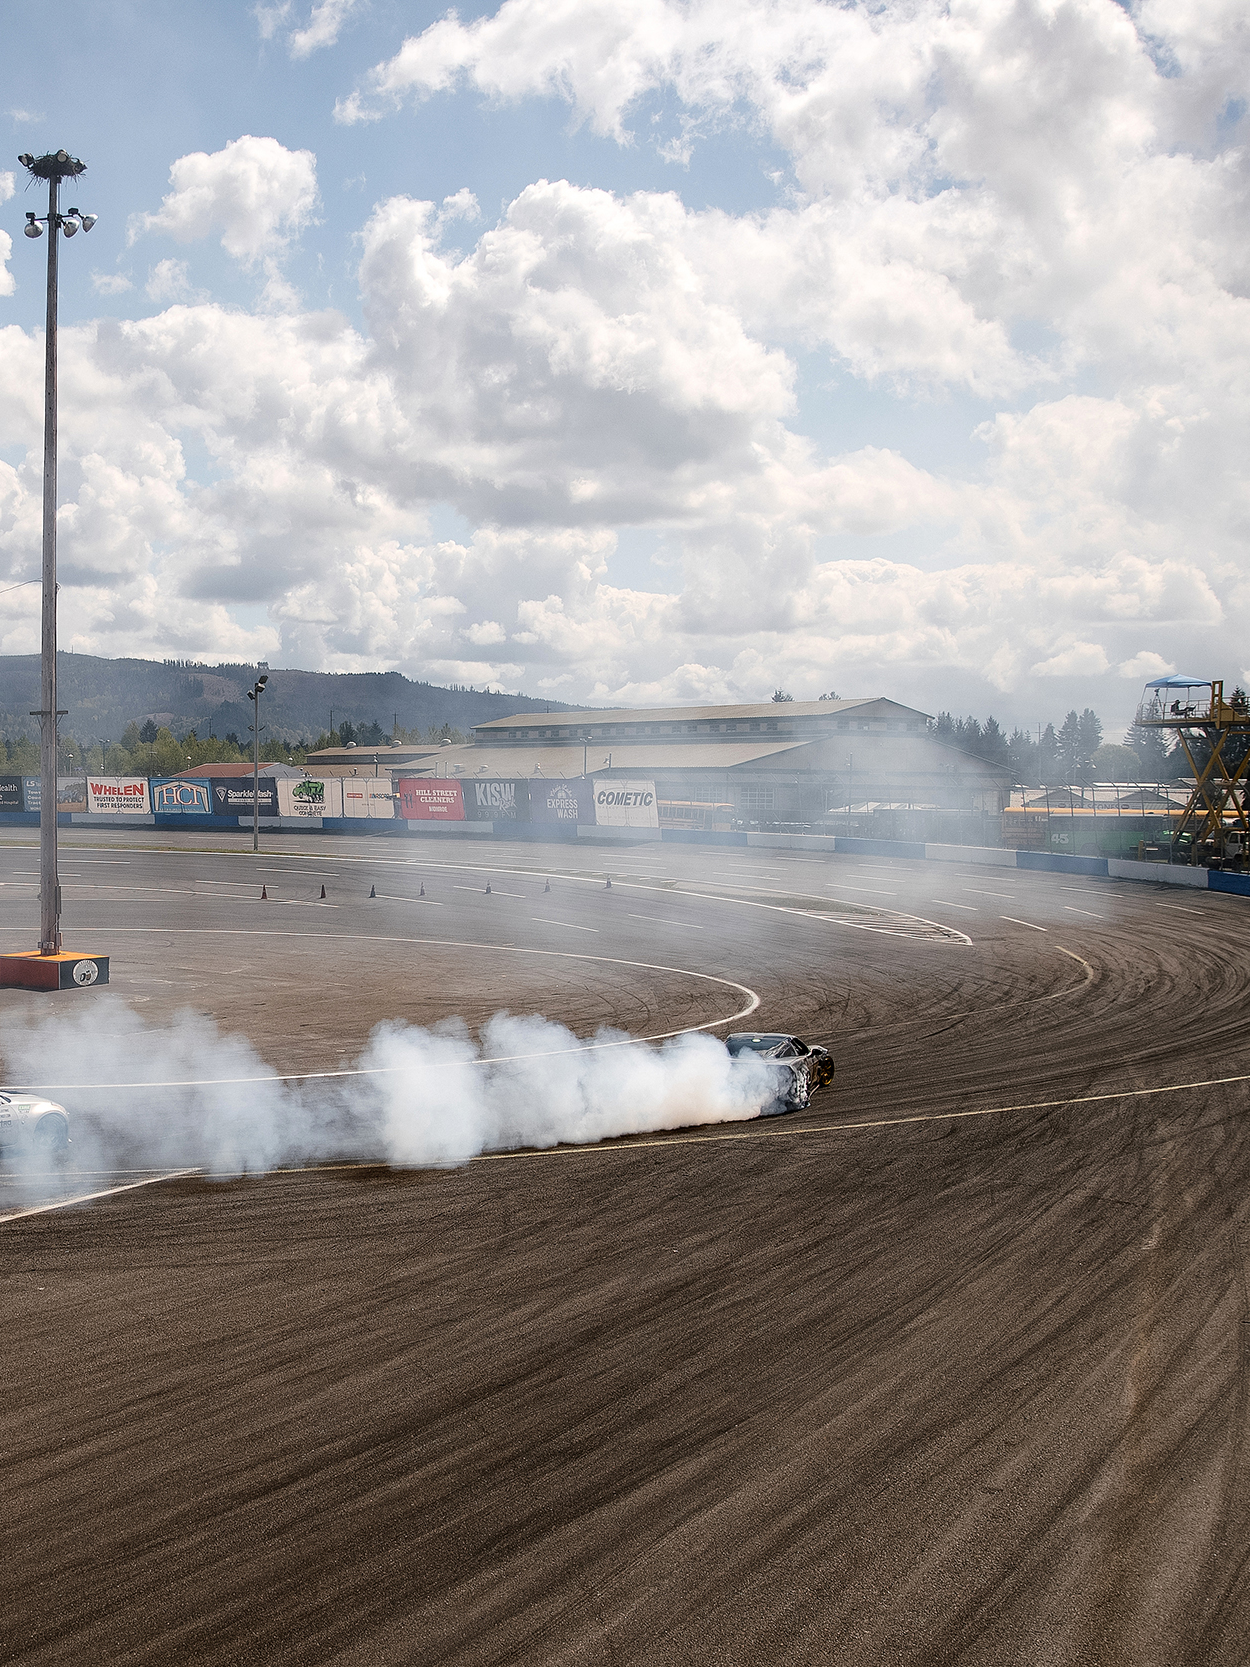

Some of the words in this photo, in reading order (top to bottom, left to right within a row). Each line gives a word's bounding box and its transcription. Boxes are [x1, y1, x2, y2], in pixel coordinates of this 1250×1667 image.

[90, 782, 144, 796] WHELEN
[162, 787, 200, 805] HCI
[475, 783, 515, 805] KISW
[547, 799, 578, 808] EXPRESS
[597, 791, 653, 806] COMETIC
[557, 809, 578, 819] WASH
[1051, 833, 1069, 844] 45
